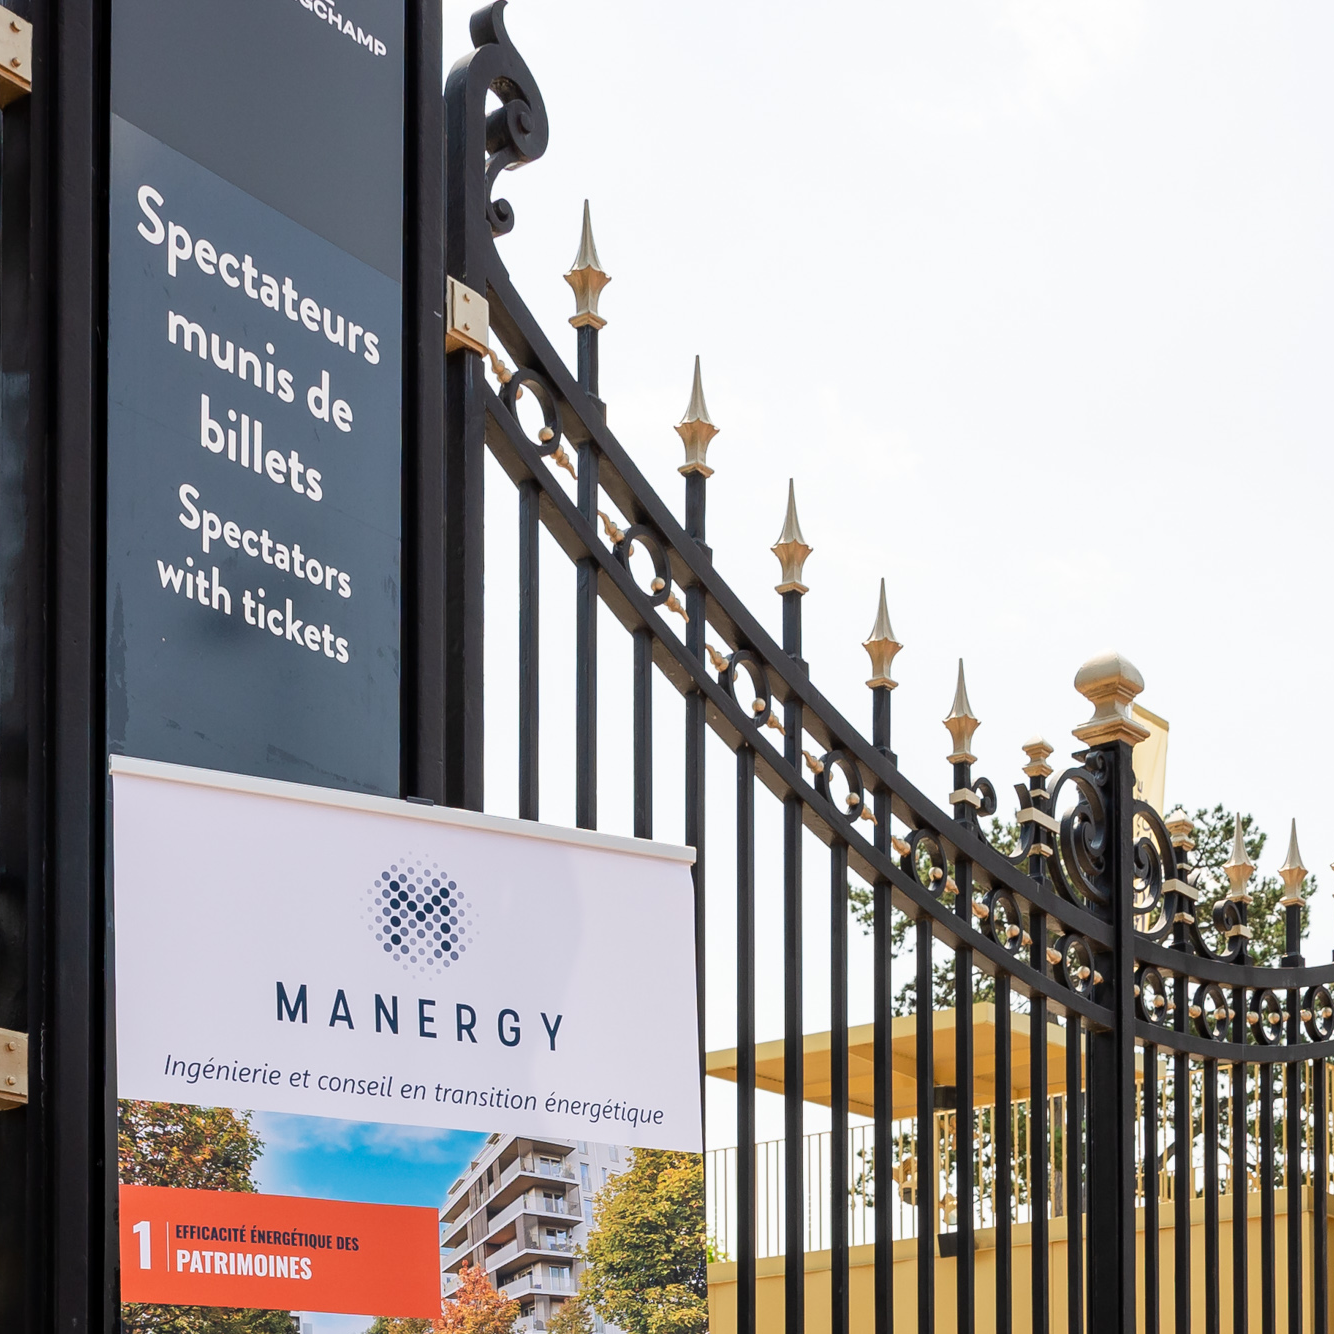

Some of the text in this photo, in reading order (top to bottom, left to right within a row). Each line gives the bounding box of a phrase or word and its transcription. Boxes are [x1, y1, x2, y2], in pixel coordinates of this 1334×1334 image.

[136, 184, 380, 365] Spectateurs
[168, 310, 354, 432] munis de
[201, 394, 323, 501] billets
[178, 484, 352, 598] Spectators
[157, 557, 349, 663] with tickets
[275, 981, 563, 1051] MANERGY
[164, 1054, 664, 1128] Ingénierie et conseil en transition énergétique
[132, 1220, 152, 1270] 1
[175, 1223, 359, 1252] EFFICACITÉ ÉNERGÉTIQUE DES
[176, 1248, 312, 1281] PATRIMOINES
